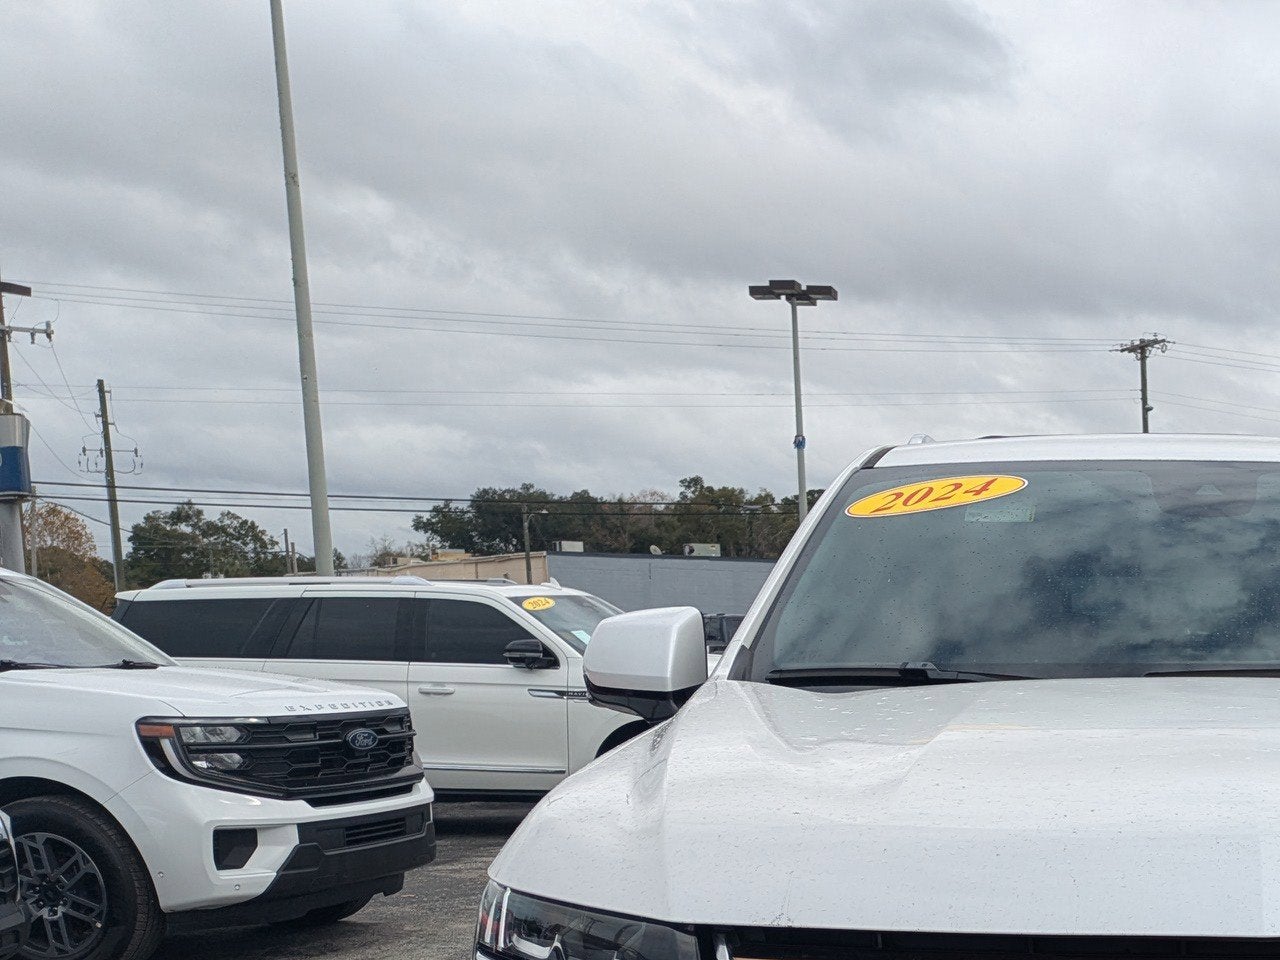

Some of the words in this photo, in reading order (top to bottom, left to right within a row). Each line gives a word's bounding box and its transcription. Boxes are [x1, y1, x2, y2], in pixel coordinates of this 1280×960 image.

[869, 477, 999, 514] 2024
[528, 597, 551, 609] 2024
[284, 700, 394, 712] EXPEDITION
